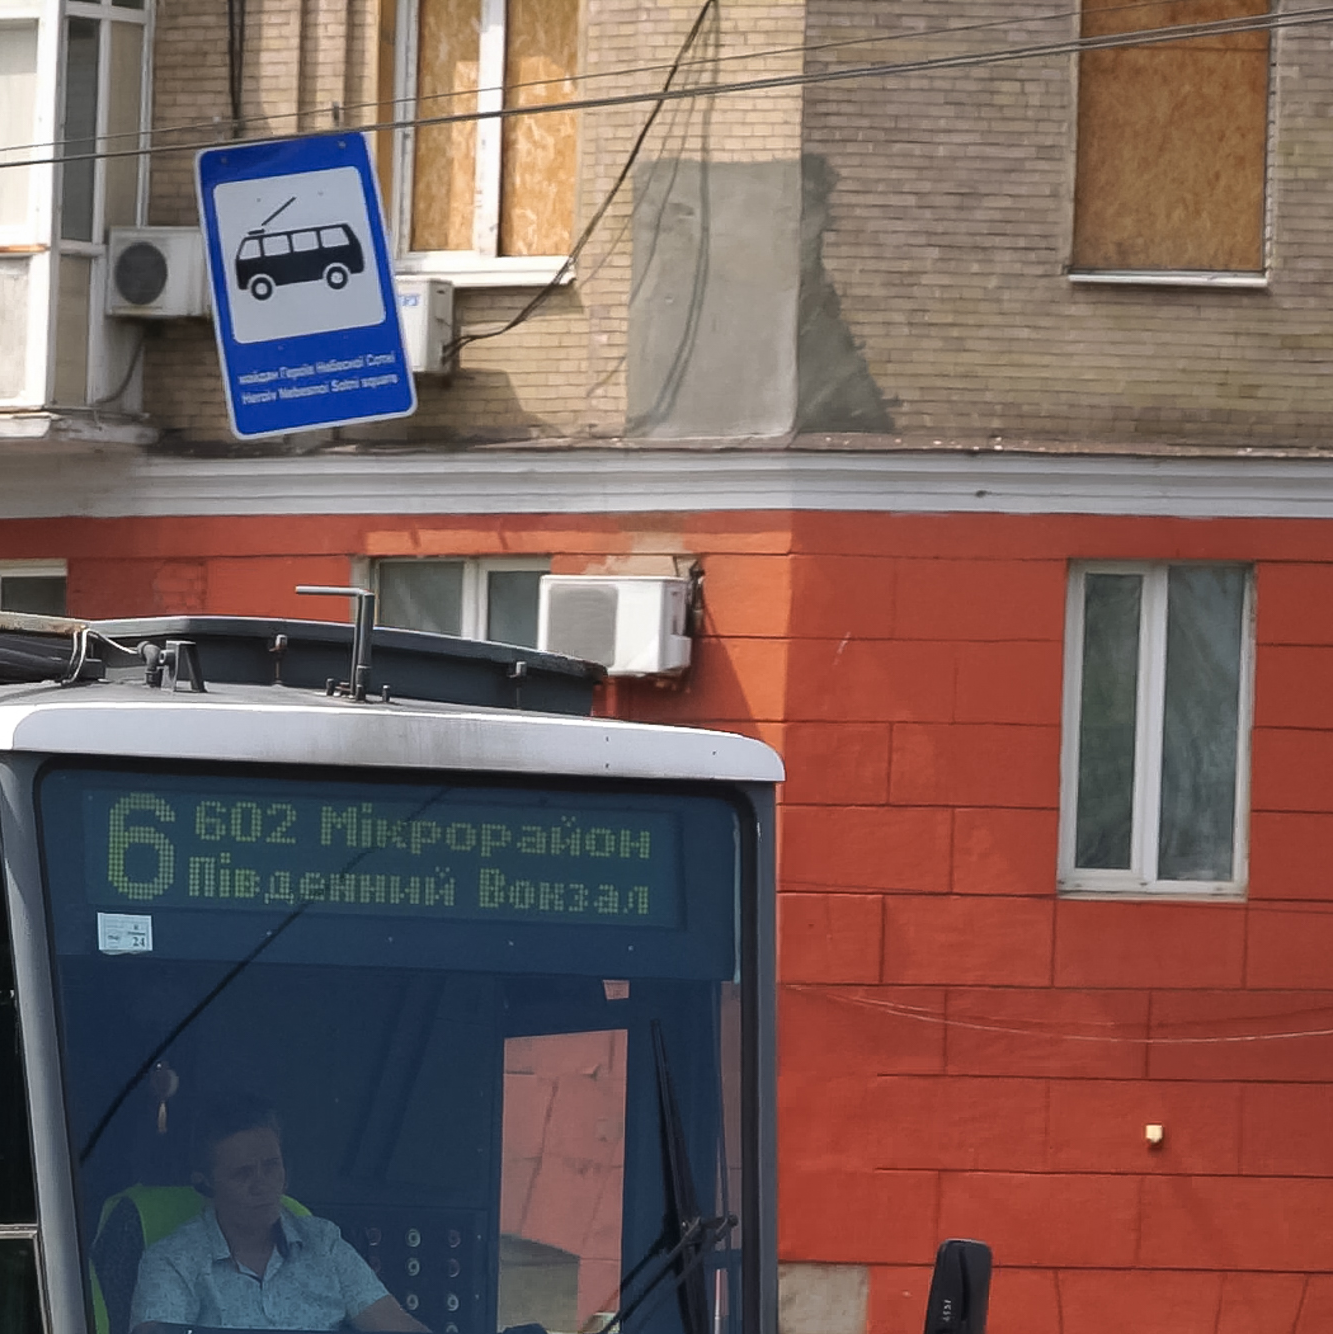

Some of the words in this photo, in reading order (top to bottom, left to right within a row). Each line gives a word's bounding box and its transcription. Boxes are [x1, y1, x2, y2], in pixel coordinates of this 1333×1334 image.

[108, 793, 175, 900] 6
[195, 801, 296, 845] 602
[321, 803, 650, 859] Мікрорайон
[189, 852, 455, 905] Південний
[480, 868, 649, 915] Вокзал
